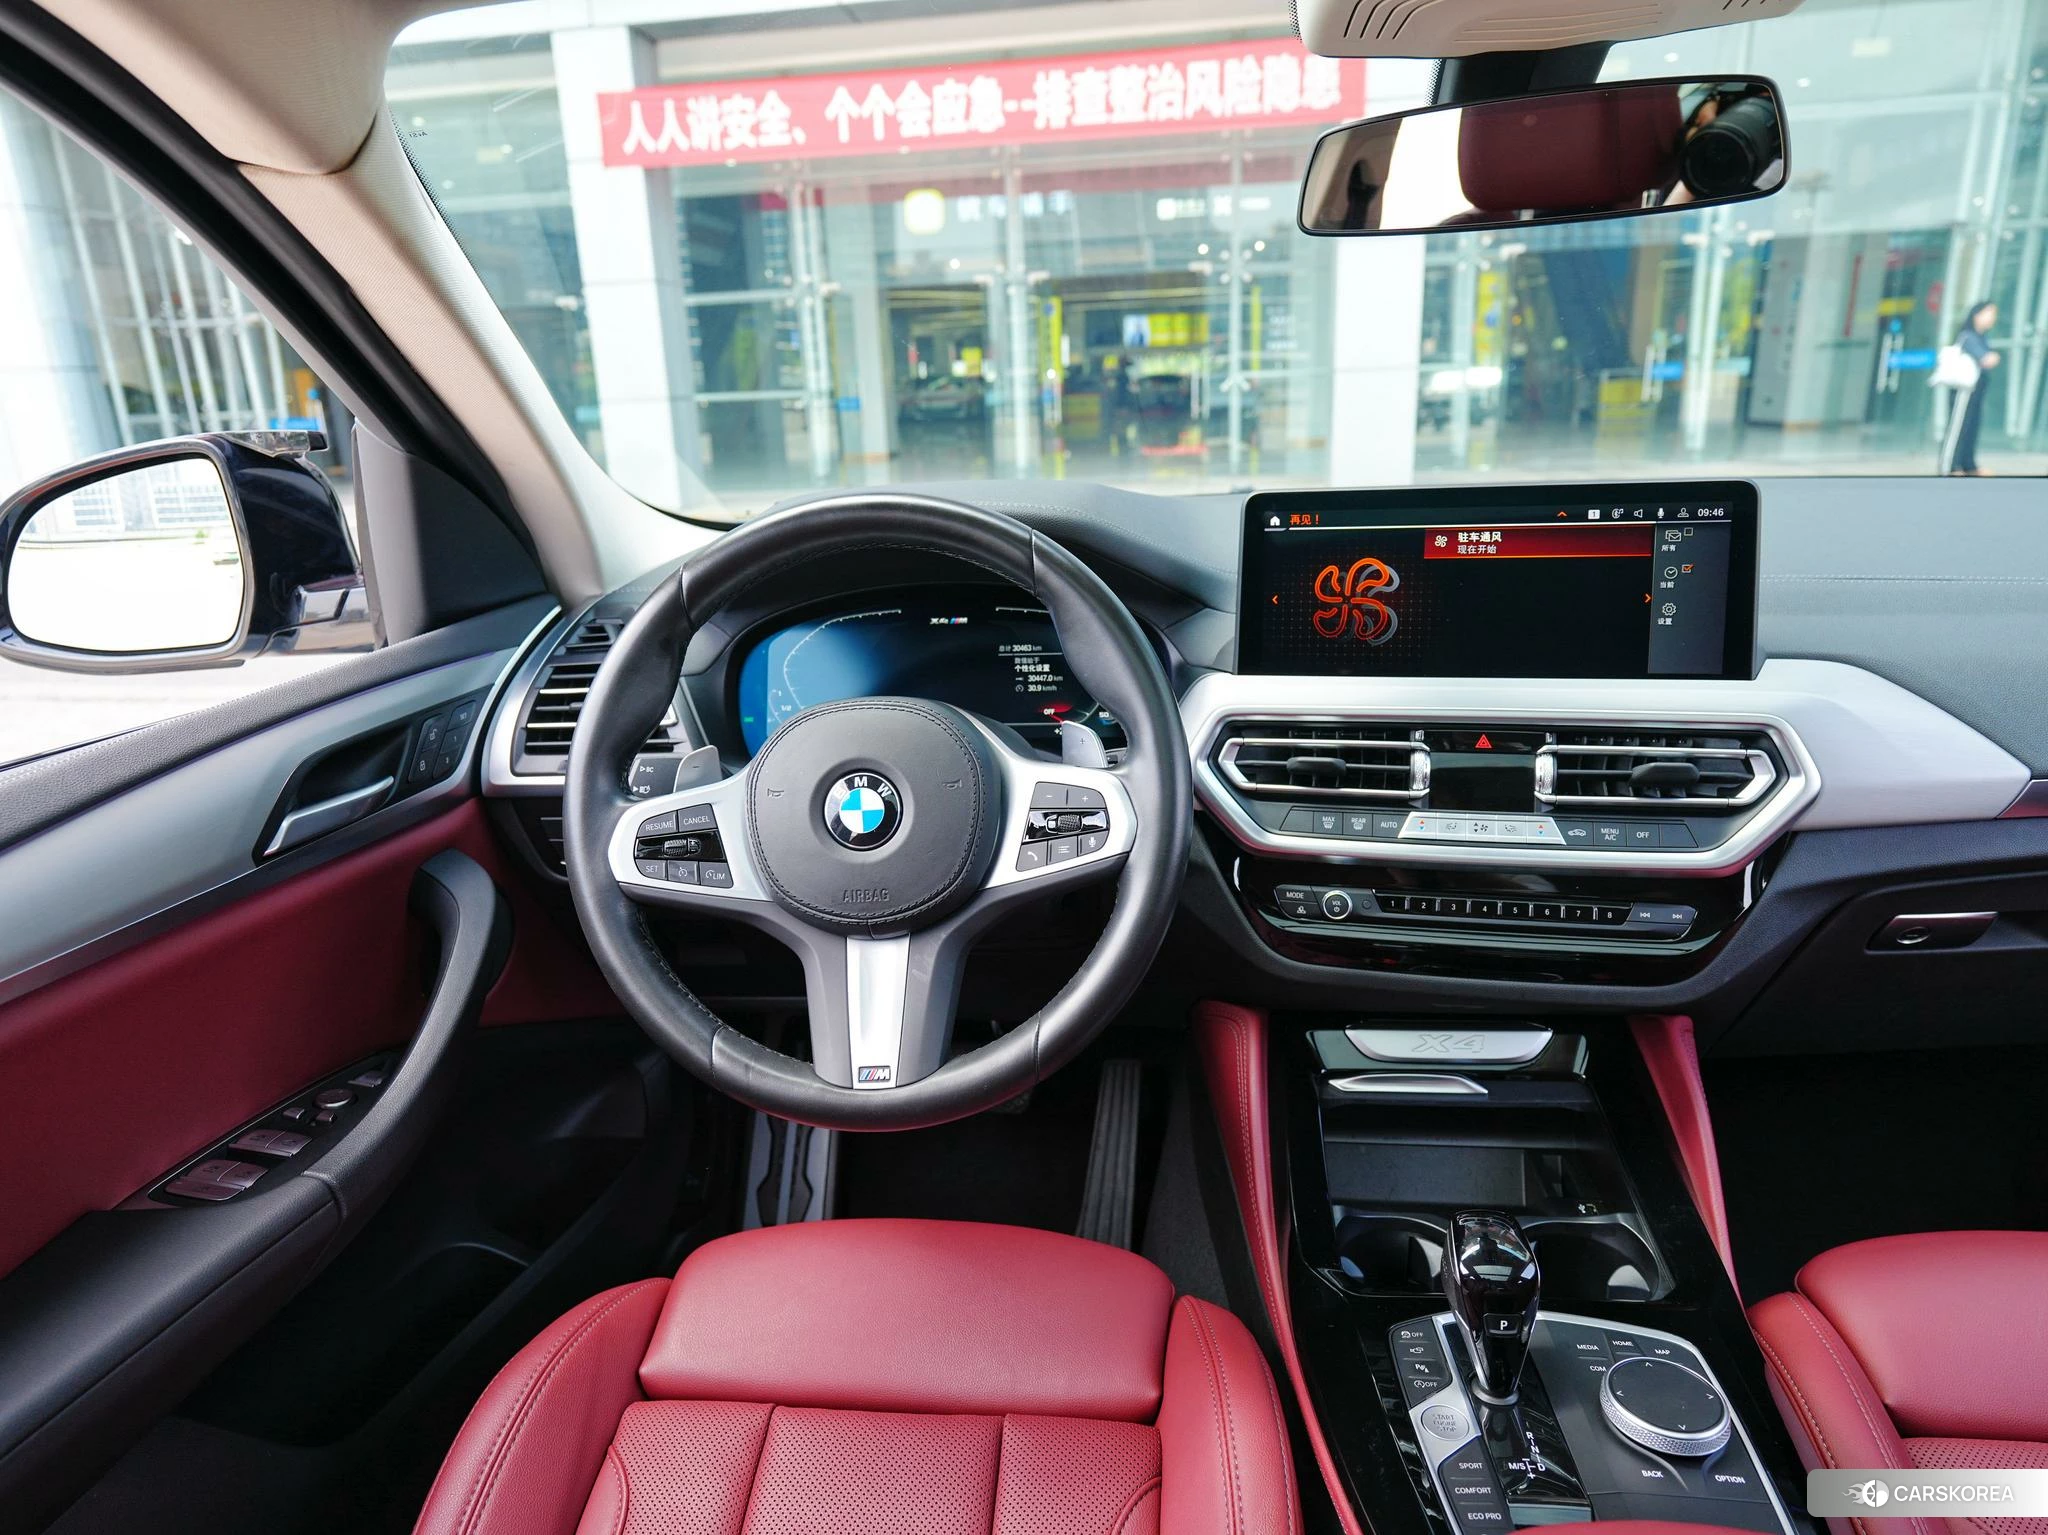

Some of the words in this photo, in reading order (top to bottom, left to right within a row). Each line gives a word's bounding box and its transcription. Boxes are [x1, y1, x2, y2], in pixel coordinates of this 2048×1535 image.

[1697, 508, 1725, 517] 09:46
[1289, 514, 1320, 526] 再见！
[1457, 531, 1502, 543] 驻车通风
[1457, 544, 1497, 554] 现在开始
[1657, 617, 1673, 625] 设置
[835, 776, 892, 800] BMW
[683, 815, 710, 826] CANCEL
[1380, 821, 1398, 829] AUTO
[645, 820, 673, 831] RESUME
[1600, 827, 1620, 835] MENU
[1636, 831, 1650, 839] OFF
[645, 865, 658, 873] SET
[712, 872, 726, 880] LIM
[843, 888, 890, 903] AIRBAG
[1286, 891, 1304, 899] MODE
[1411, 1033, 1486, 1053] X4
[1500, 1320, 1508, 1331] P
[1526, 1431, 1534, 1440] R
[1530, 1445, 1540, 1453] N
[1508, 1462, 1526, 1470] M/S
[1537, 1463, 1546, 1472] D
[1641, 1470, 1664, 1478] BACK
[1714, 1474, 1746, 1484] OPTION
[1467, 1512, 1484, 1520] ECO
[1485, 1512, 1502, 1520] PRO
